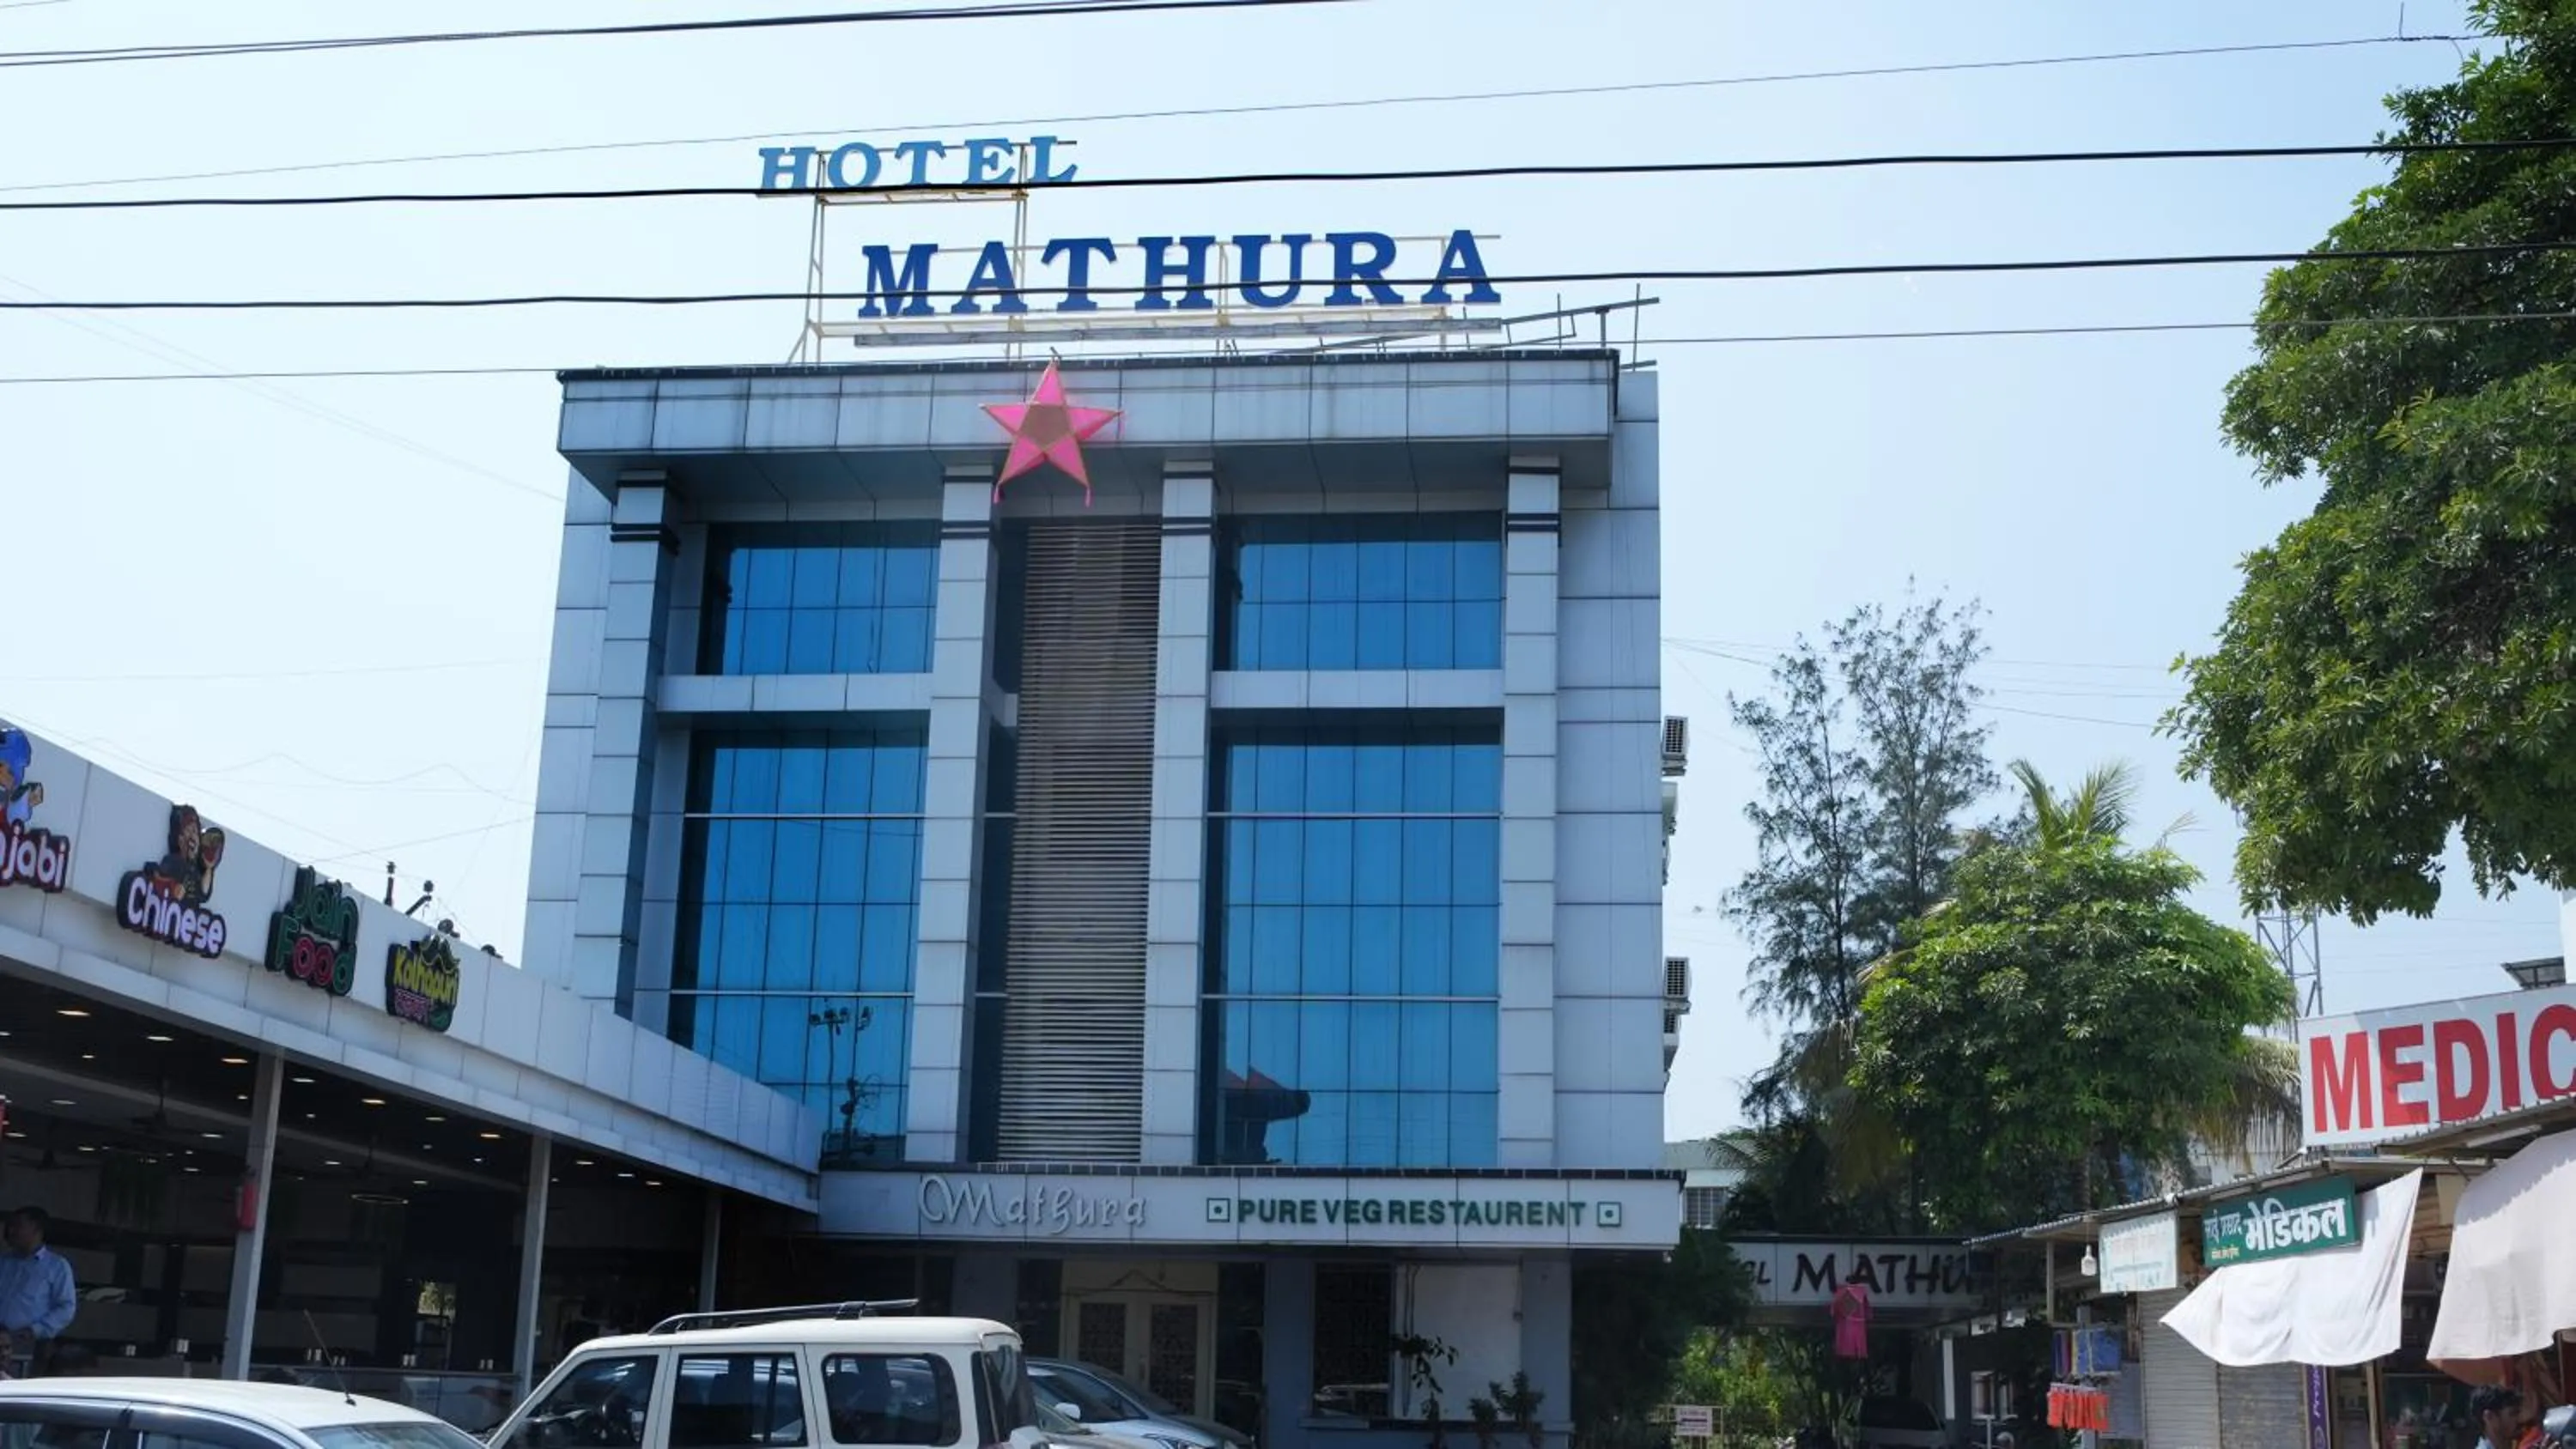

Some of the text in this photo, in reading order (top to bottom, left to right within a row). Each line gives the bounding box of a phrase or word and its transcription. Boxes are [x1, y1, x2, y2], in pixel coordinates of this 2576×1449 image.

[758, 136, 1078, 192] HOTEL
[859, 229, 1502, 318] MATHURA
[127, 876, 224, 955] Chinese
[292, 867, 357, 946] Jain
[274, 913, 355, 994] Food
[2309, 1003, 2576, 1134] MEDIC
[919, 1175, 1149, 1235] Mathura
[1238, 1198, 1586, 1228] PURE VEG RESTAURENT
[2244, 1197, 2347, 1251] मेडिकल
[1792, 1252, 1973, 1294] MATHU
